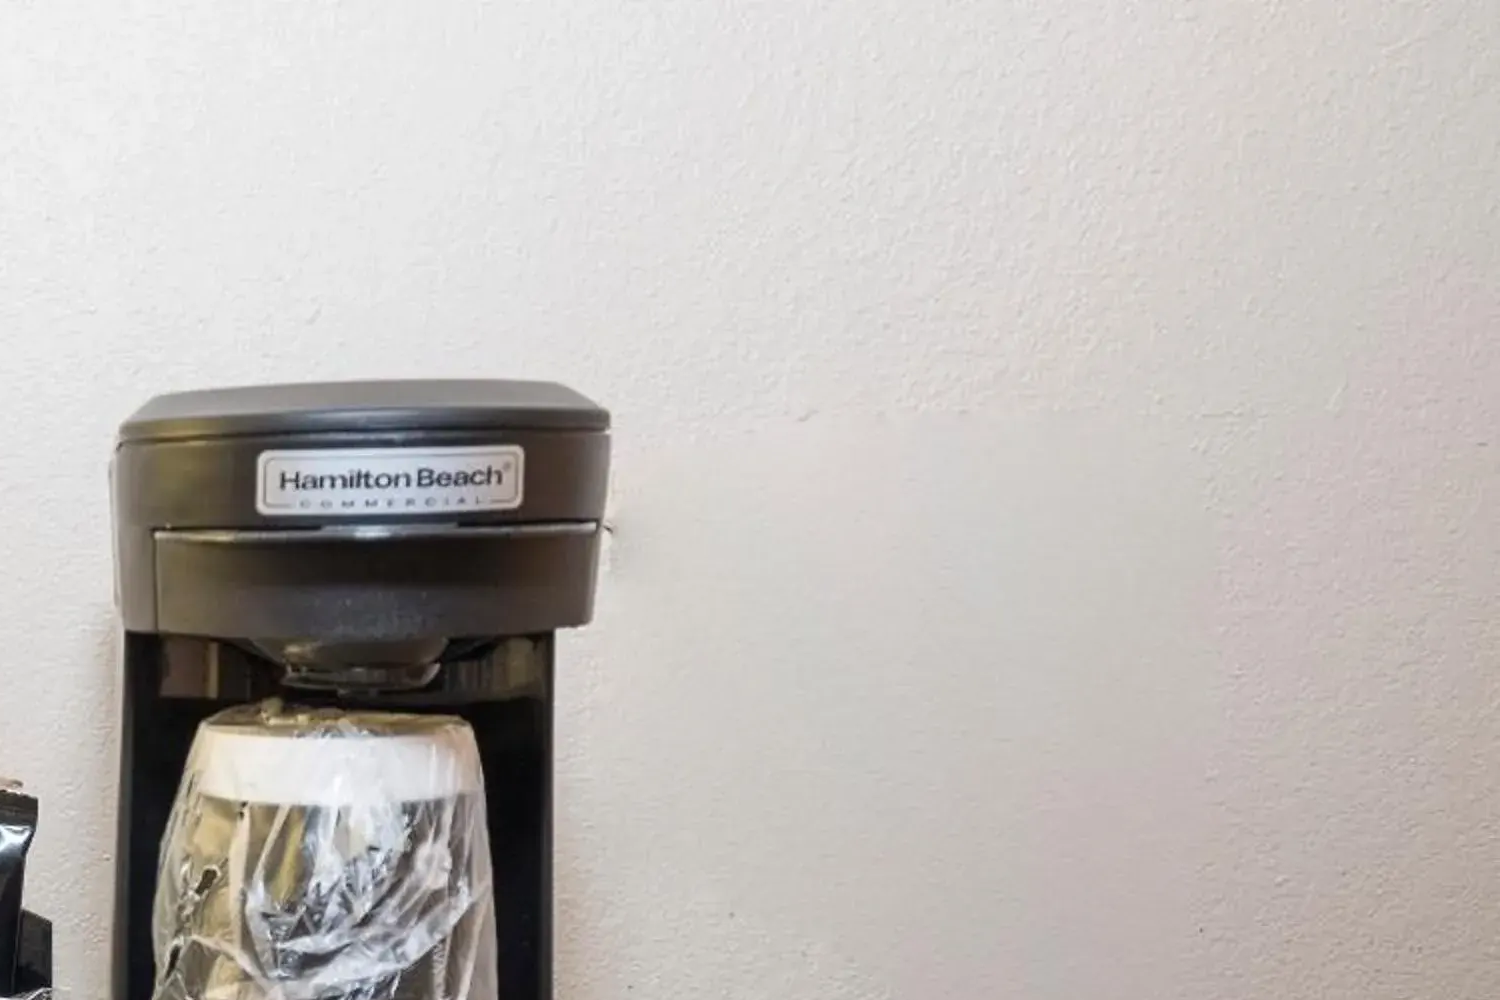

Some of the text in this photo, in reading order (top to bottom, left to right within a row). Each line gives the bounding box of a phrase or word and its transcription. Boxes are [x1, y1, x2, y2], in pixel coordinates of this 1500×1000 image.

[279, 465, 503, 491] Hamilton Beach
[299, 495, 484, 509] COMMERCIAL
